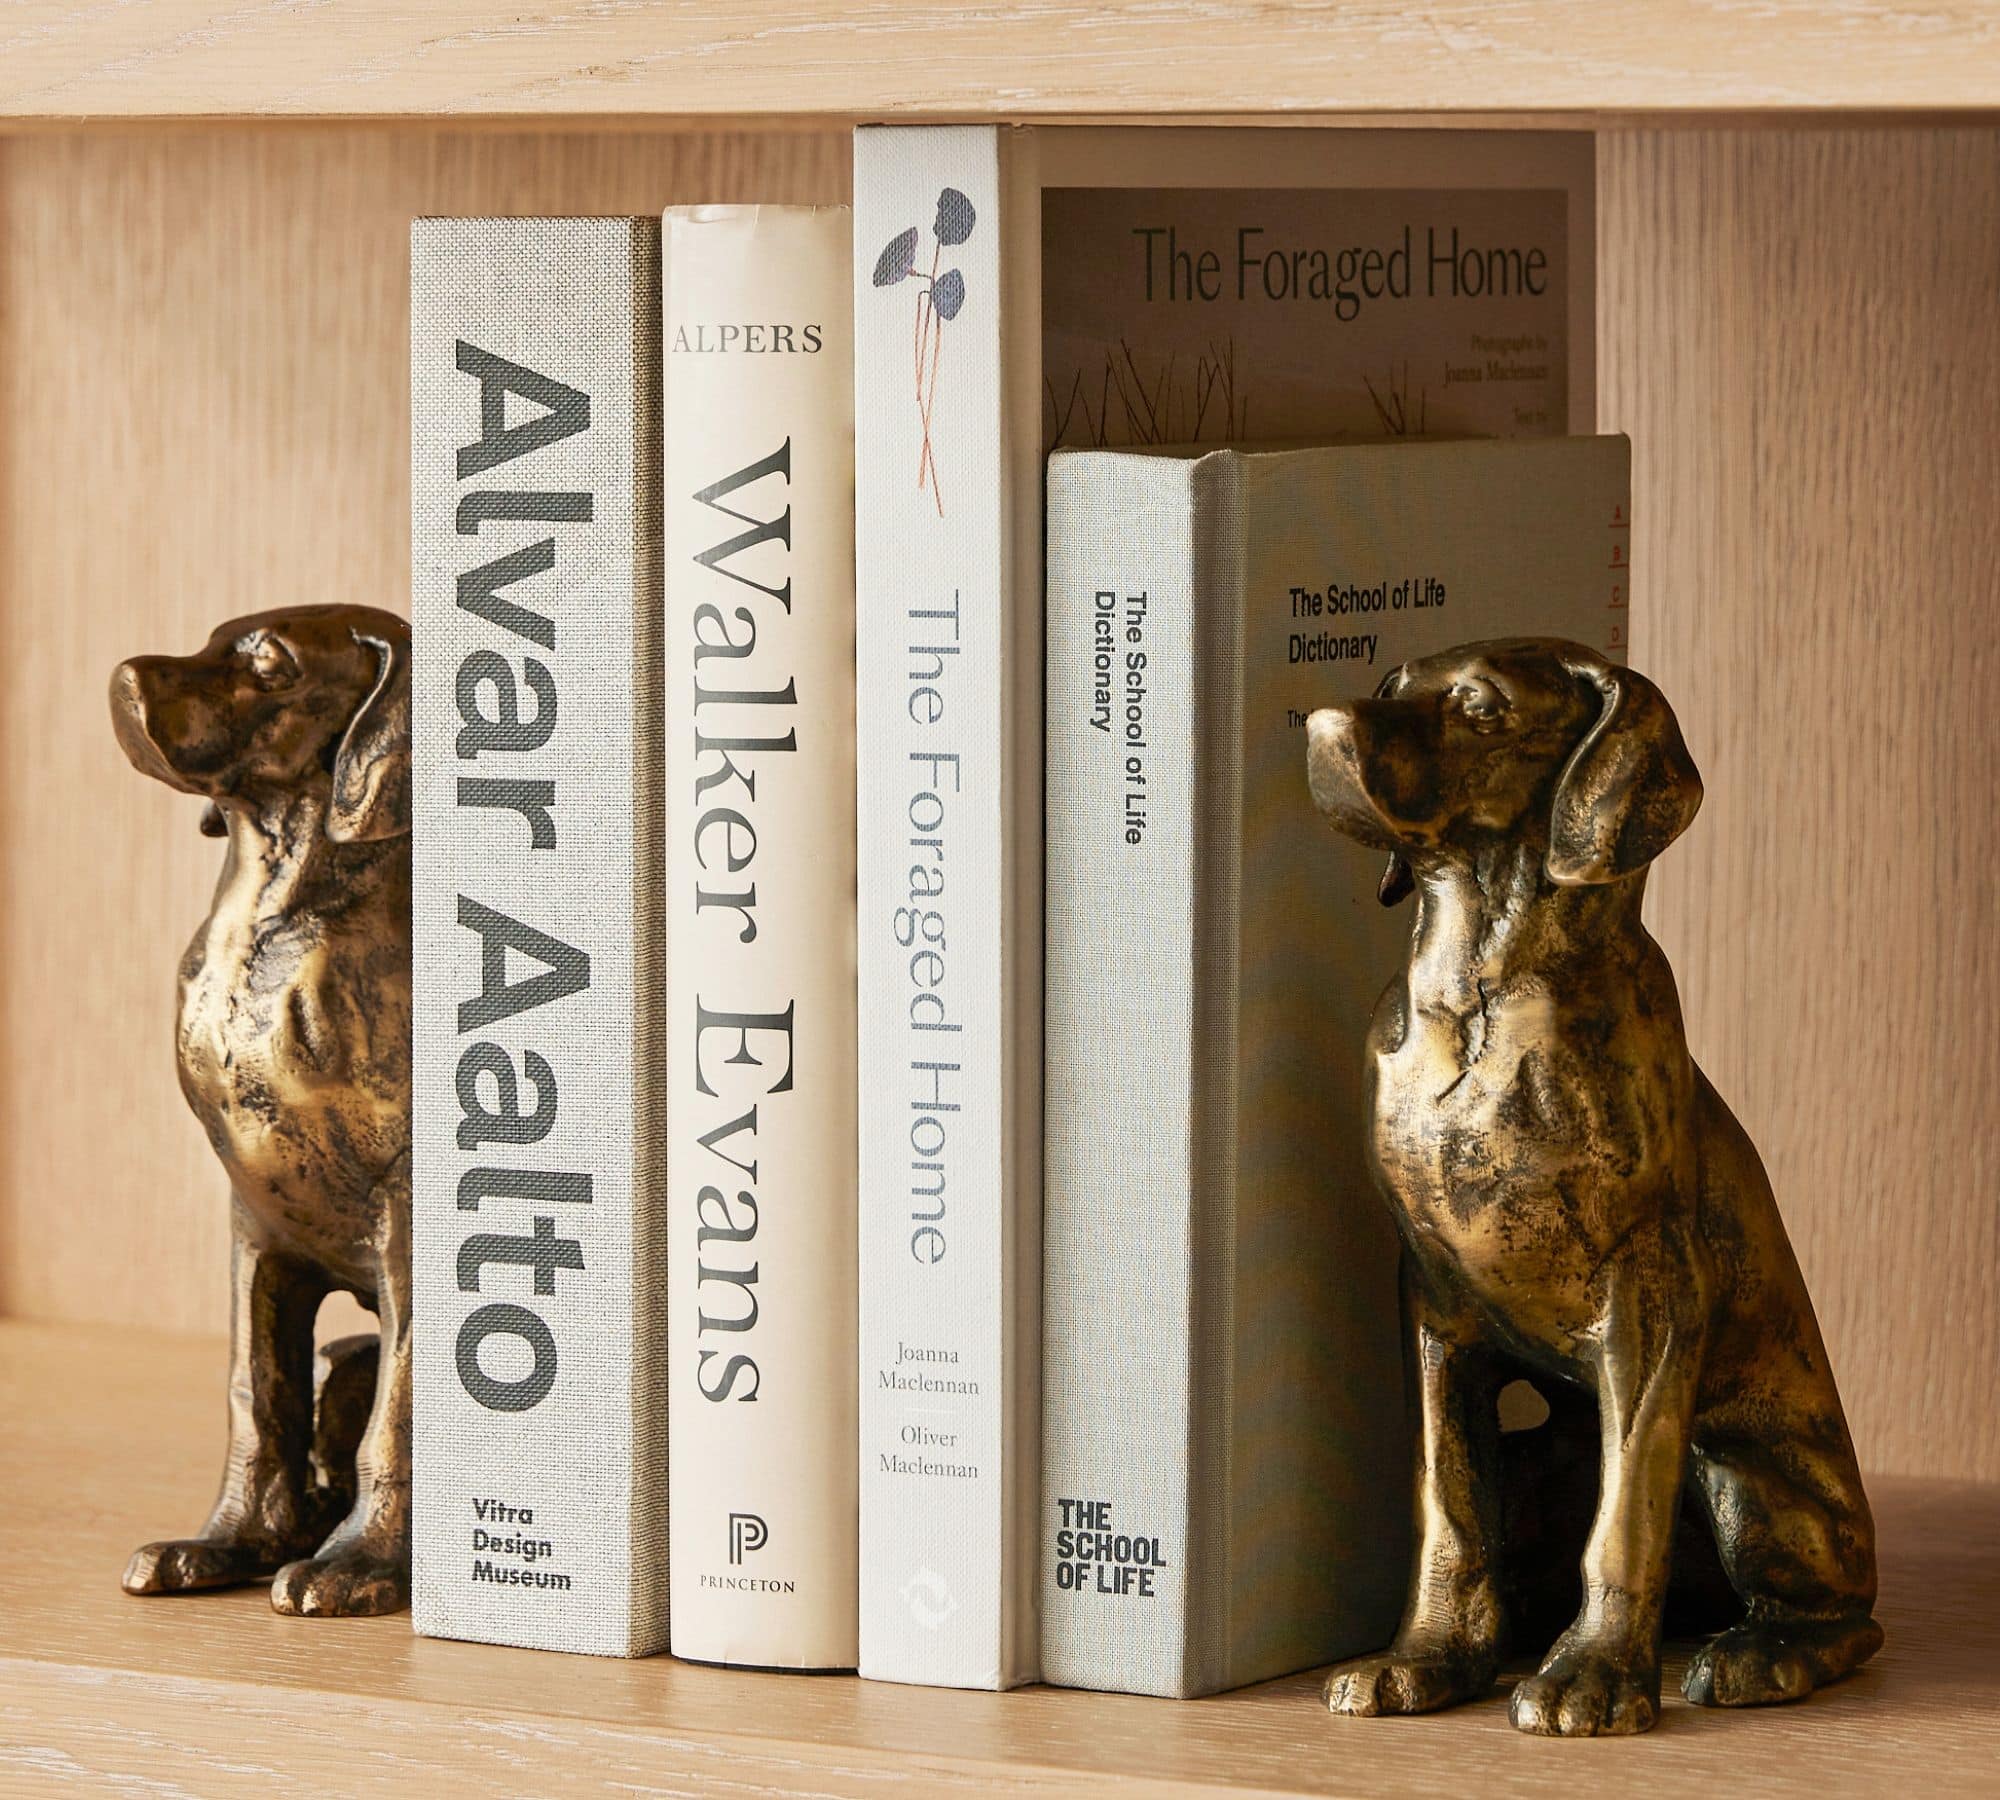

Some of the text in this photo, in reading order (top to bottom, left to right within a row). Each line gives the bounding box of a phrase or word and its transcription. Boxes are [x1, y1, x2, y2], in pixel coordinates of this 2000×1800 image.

[1132, 225, 1547, 321] The Foraged Home
[671, 324, 823, 353] ALPERS
[456, 338, 593, 850] Alvar
[1289, 578, 1446, 618] The School of Life
[1090, 591, 1116, 733] Dictionary
[1289, 633, 1378, 666] Dictionary
[692, 435, 798, 944] Walker
[1125, 591, 1147, 845] The School of Life
[1287, 709, 1307, 728] The
[893, 588, 963, 1265] The Foraged Home
[456, 893, 593, 1412] Aalto
[696, 992, 795, 1403] Evans
[895, 1342, 960, 1365] Joanna
[879, 1370, 979, 1395] Maclennan
[901, 1425, 957, 1447] Oliver
[880, 1453, 978, 1478] Maclennan
[472, 1497, 533, 1525] Vitra
[1058, 1499, 1112, 1531] THE
[473, 1528, 552, 1562] Design
[1057, 1530, 1167, 1567] SCHOOL
[472, 1559, 571, 1591] Museum
[700, 1574, 795, 1593] PRINCETON
[1057, 1561, 1155, 1597] OF LIFE
